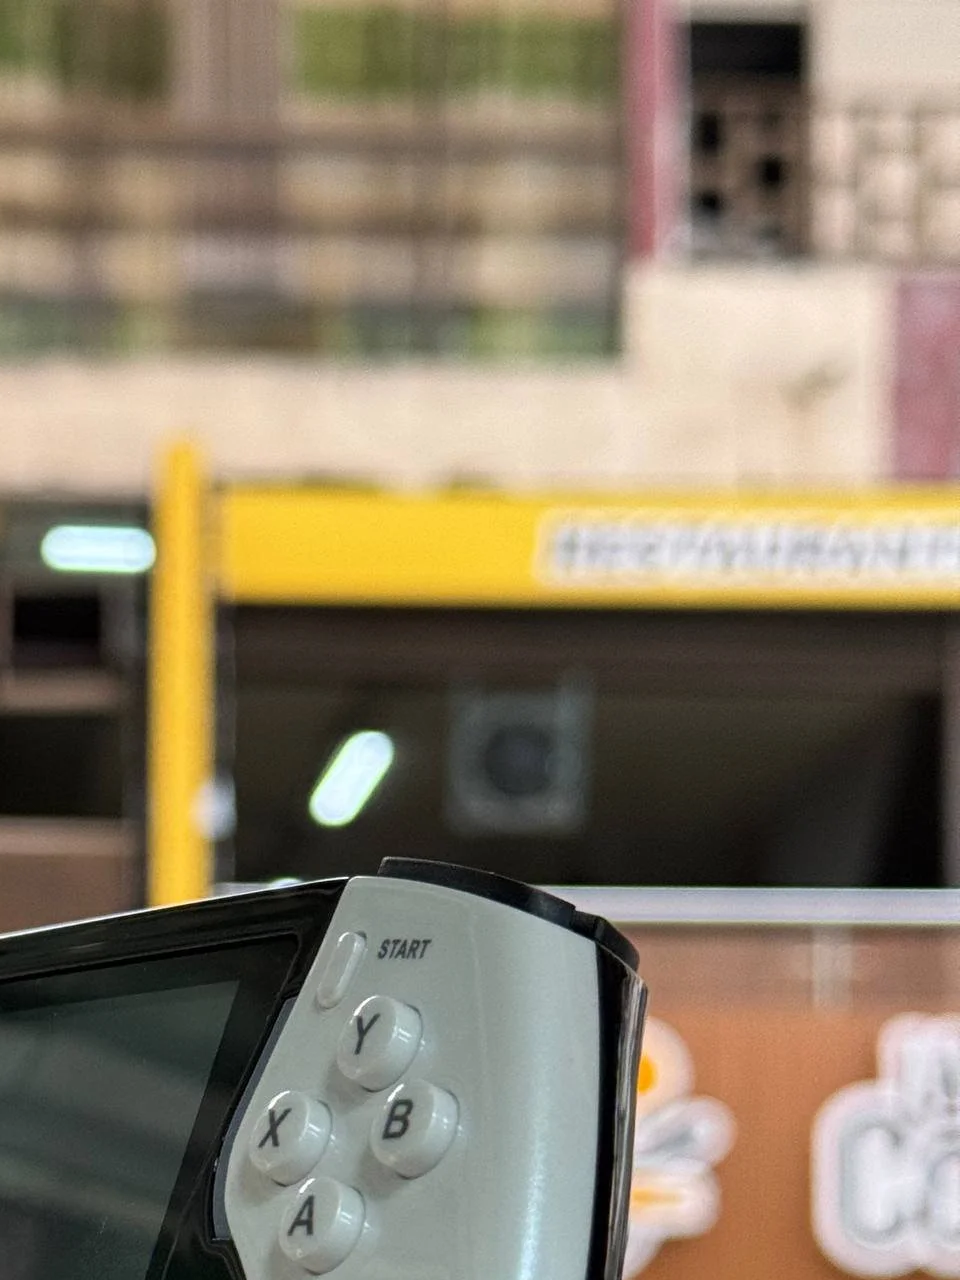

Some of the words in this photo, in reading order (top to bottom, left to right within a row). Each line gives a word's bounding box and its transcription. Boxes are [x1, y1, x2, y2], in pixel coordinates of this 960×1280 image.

[378, 939, 431, 960] START
[351, 1012, 381, 1056] Y
[258, 1107, 292, 1149] X
[382, 1098, 413, 1140] B
[287, 1195, 315, 1237] A
